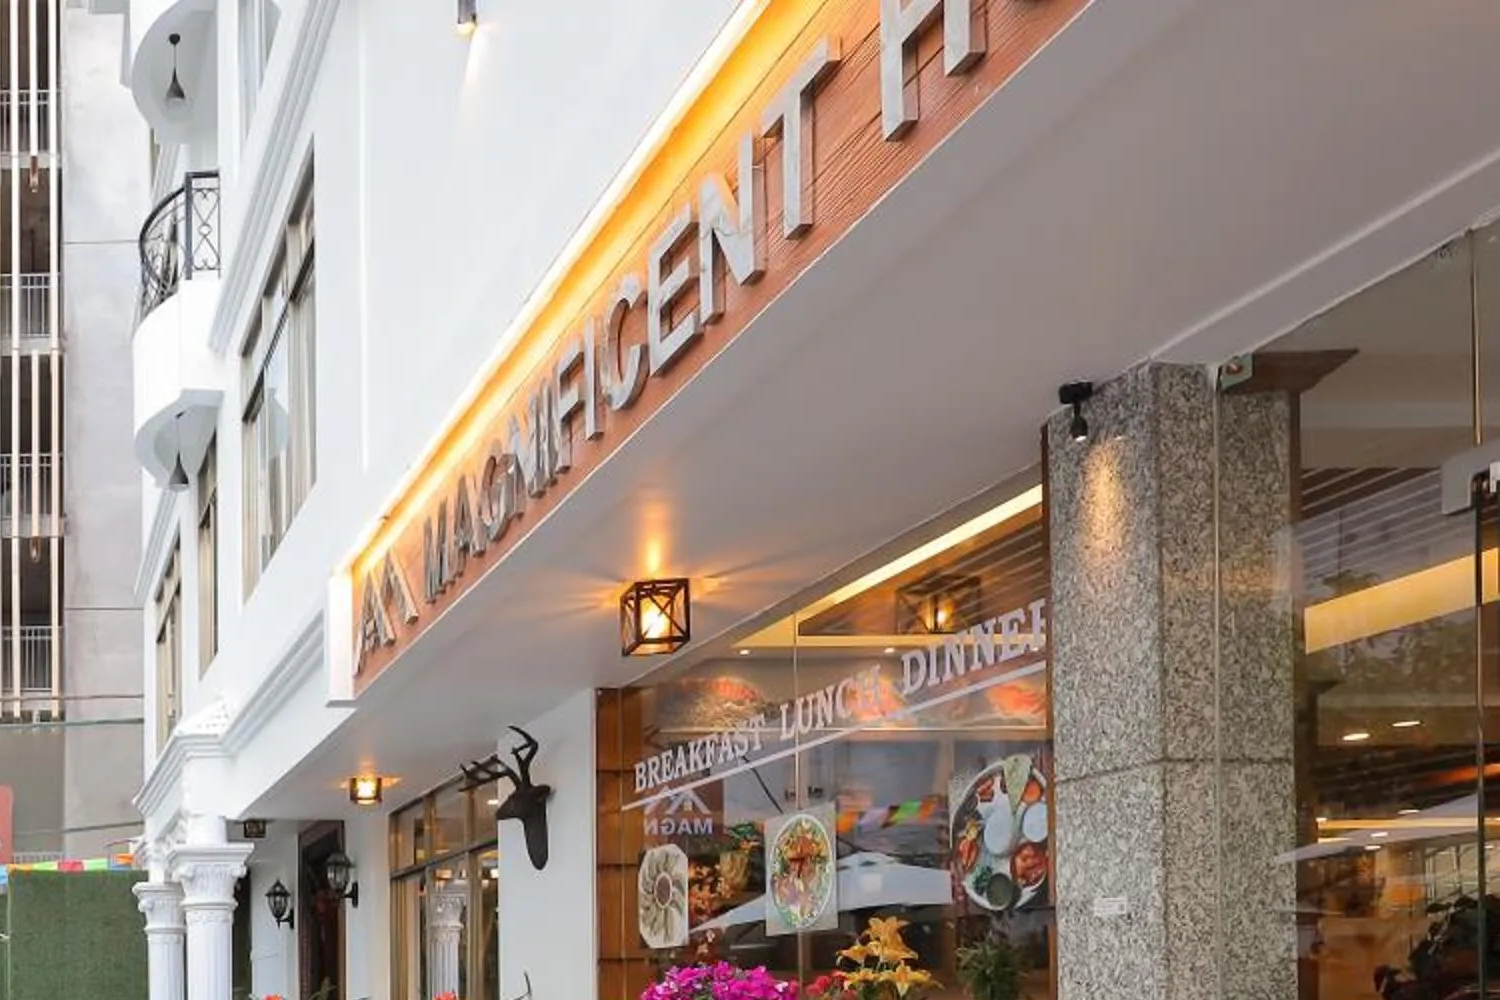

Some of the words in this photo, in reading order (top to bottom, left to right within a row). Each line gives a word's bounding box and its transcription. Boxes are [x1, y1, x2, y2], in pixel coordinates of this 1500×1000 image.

[423, 36, 842, 604] MAGNIFICENT
[633, 713, 766, 793] BREAKFAST
[779, 663, 882, 741] LUNCH
